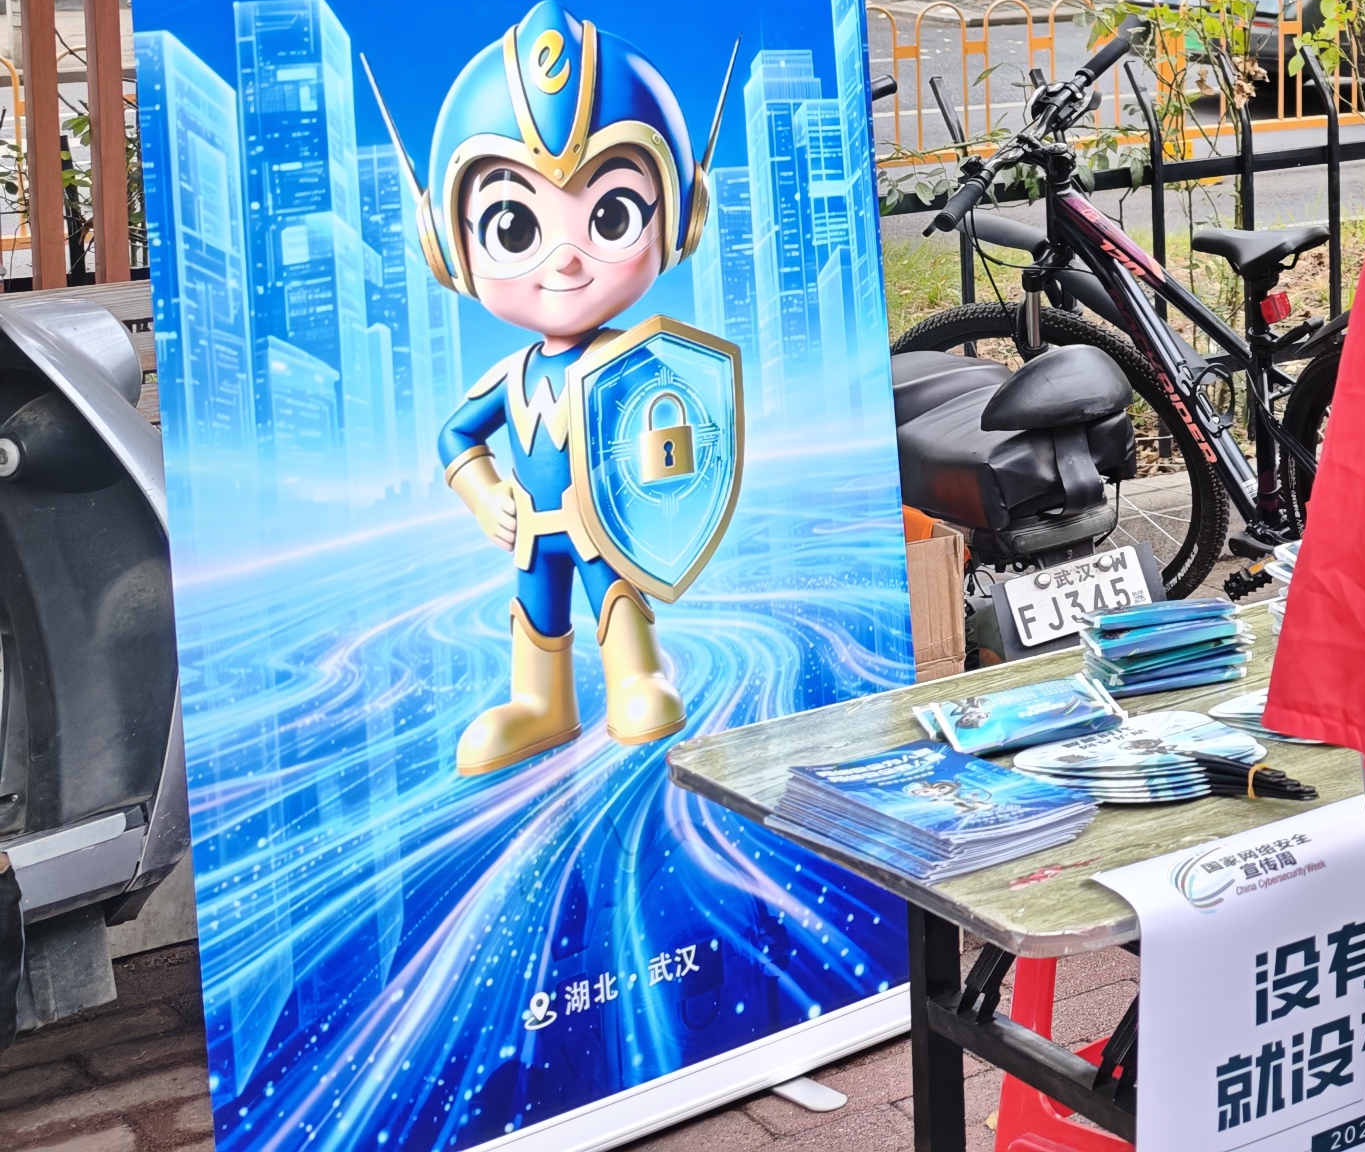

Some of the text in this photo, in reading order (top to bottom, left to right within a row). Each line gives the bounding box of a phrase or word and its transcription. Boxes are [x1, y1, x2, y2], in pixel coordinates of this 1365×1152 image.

[1018, 577, 1131, 640] FJ345
[1200, 833, 1312, 874] 国家网络安全
[1239, 851, 1298, 880] 宣传周
[1235, 859, 1327, 896] China Cybersecurity Week
[565, 945, 700, 1016] 湖北·武汉
